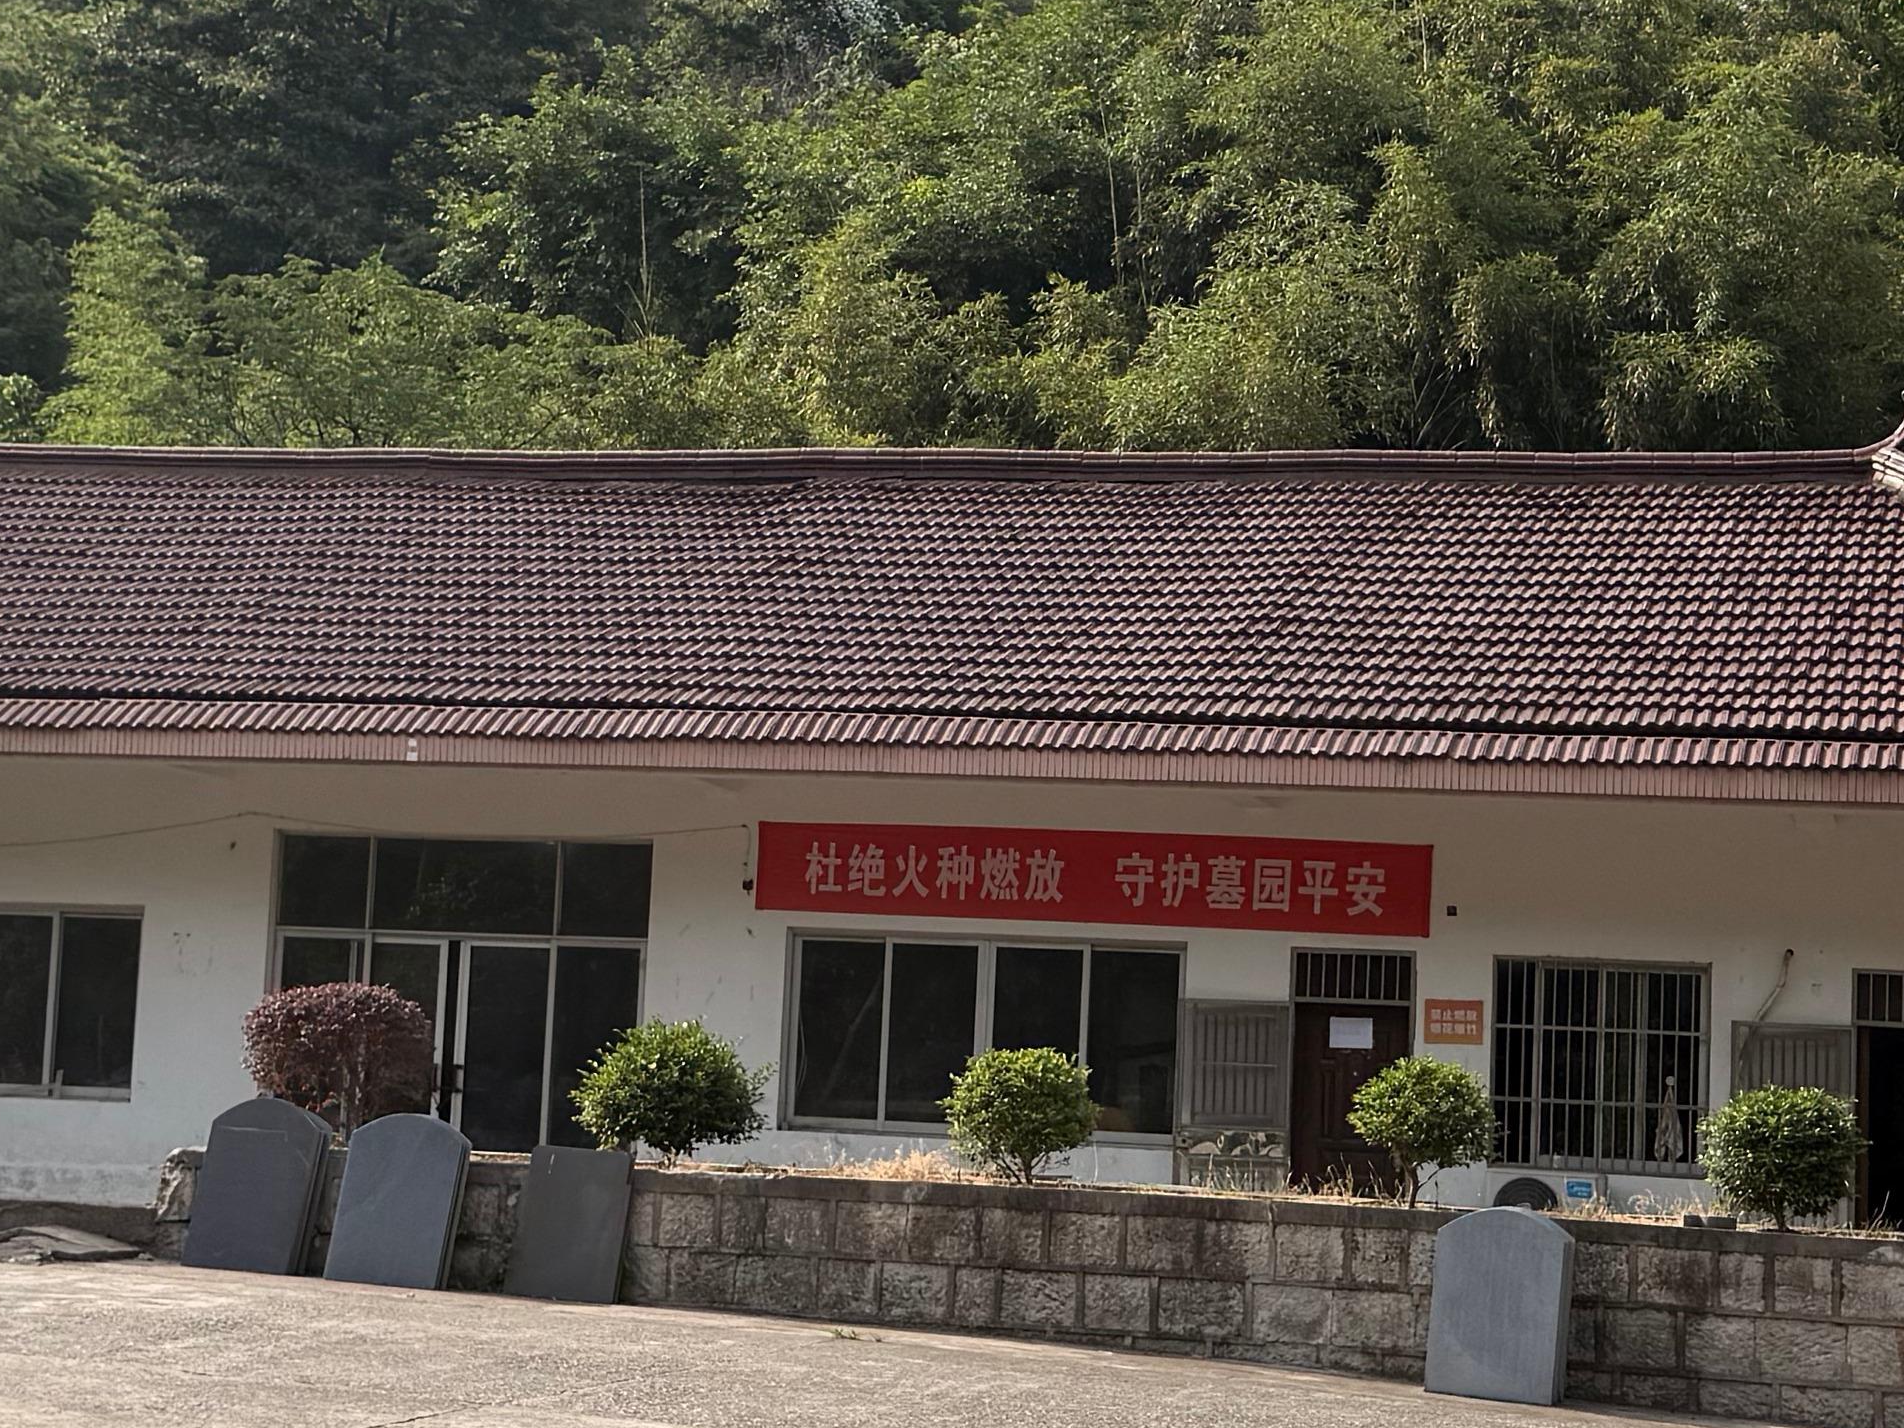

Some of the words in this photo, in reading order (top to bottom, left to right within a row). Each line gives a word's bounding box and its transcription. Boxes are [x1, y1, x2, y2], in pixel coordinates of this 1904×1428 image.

[805, 841, 1065, 903] 杜绝火种燃放
[1114, 852, 1387, 917] 守护墓园平安
